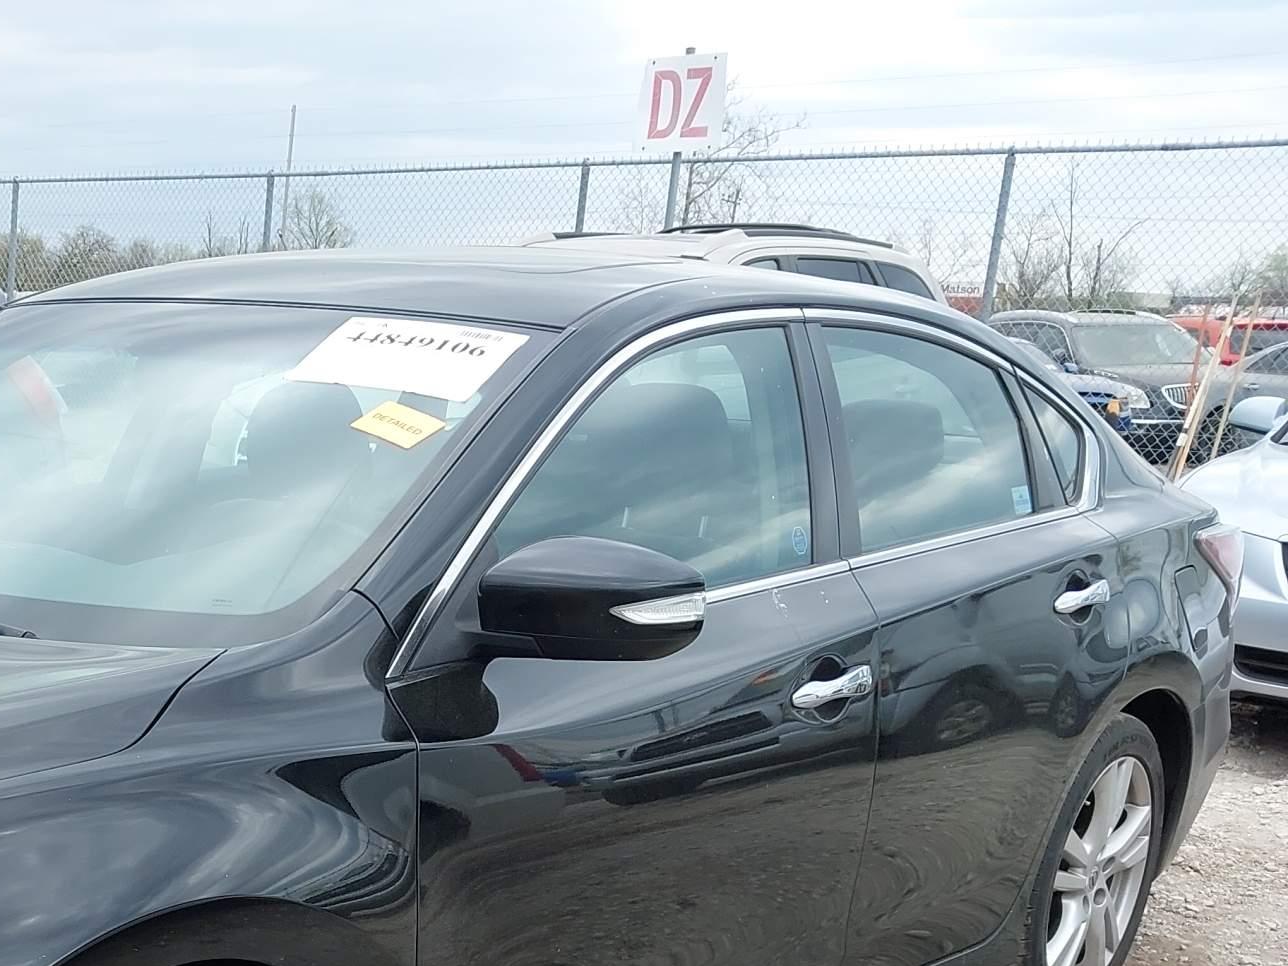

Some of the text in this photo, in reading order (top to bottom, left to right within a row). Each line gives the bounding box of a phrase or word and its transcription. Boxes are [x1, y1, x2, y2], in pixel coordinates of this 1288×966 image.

[646, 66, 713, 140] DZ
[941, 284, 980, 294] Matson
[345, 330, 486, 358] 44849106
[371, 412, 423, 437] DETAILED
